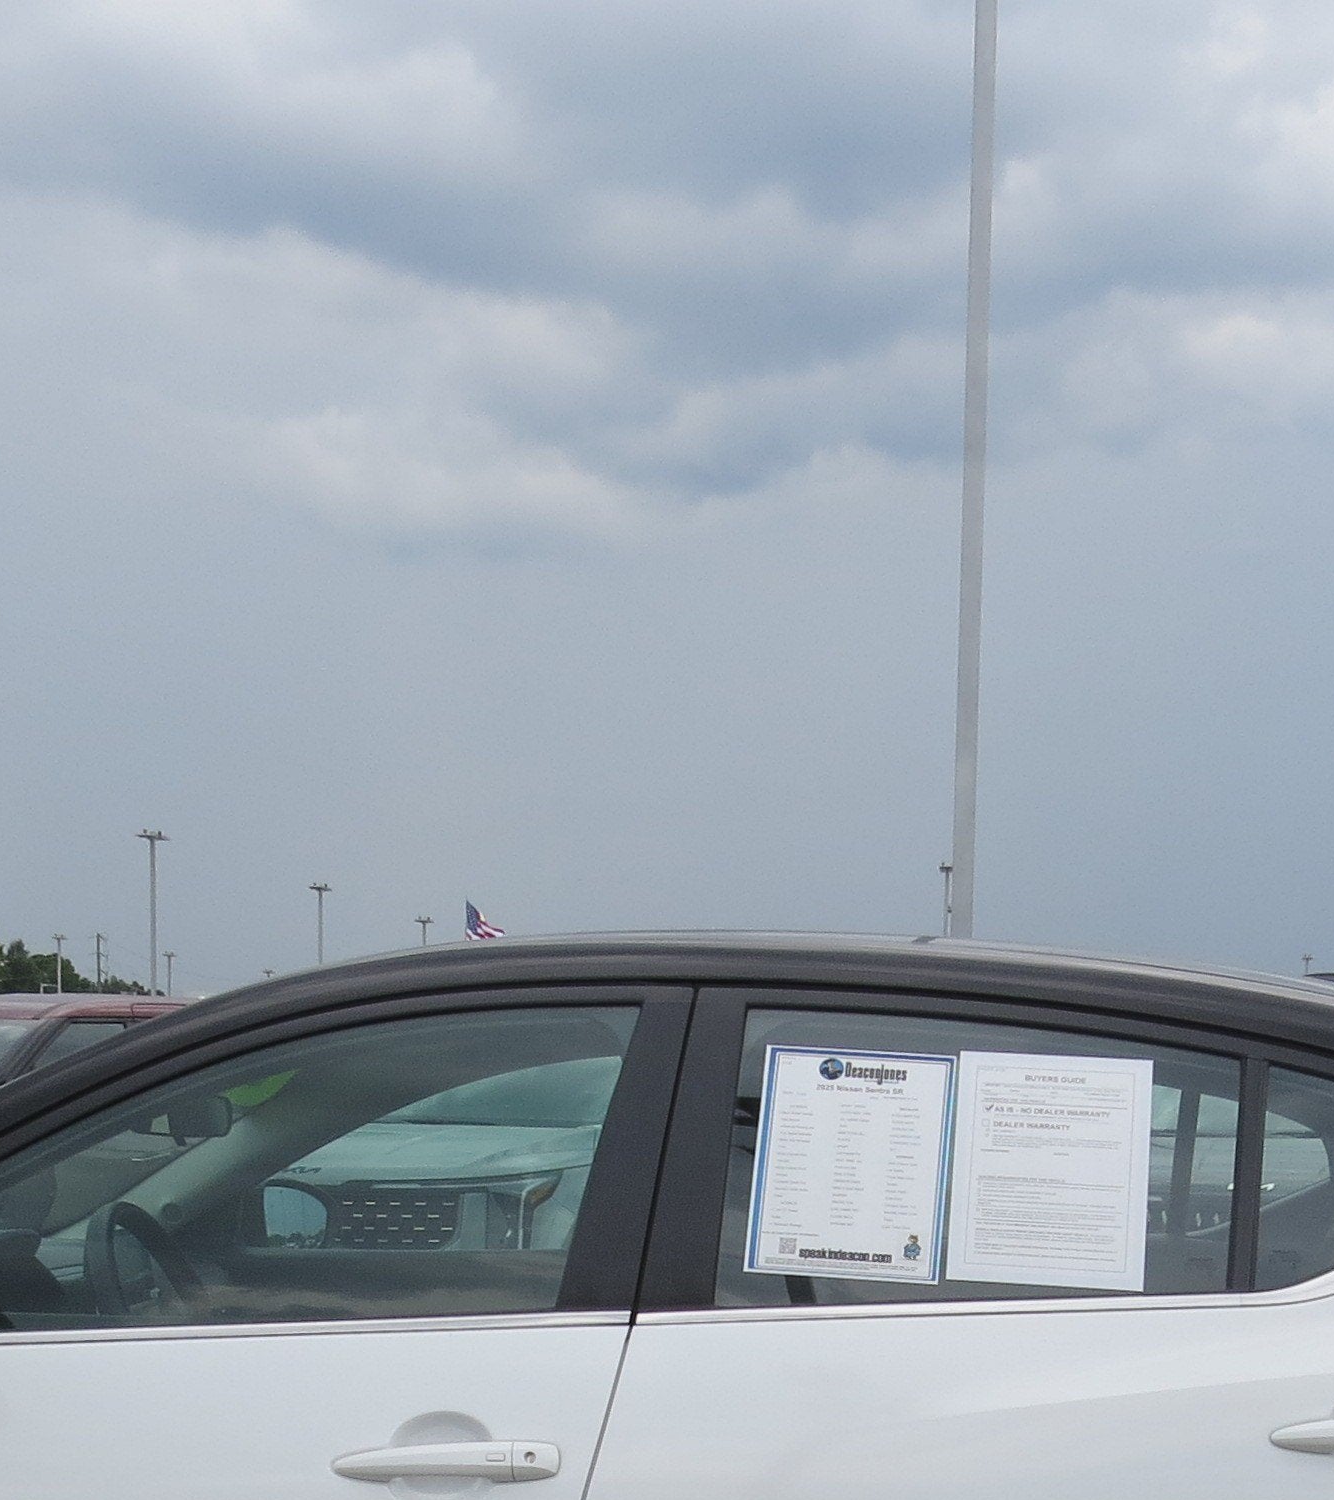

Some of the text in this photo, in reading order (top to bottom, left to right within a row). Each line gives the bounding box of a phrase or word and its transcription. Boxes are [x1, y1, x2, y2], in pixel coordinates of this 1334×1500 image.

[1024, 1074, 1087, 1084] BUYERS GUIDE
[1034, 1108, 1065, 1116] DEALER
[1067, 1110, 1110, 1118] WARRANTY
[993, 1121, 1070, 1130] DEALER WARRANTY
